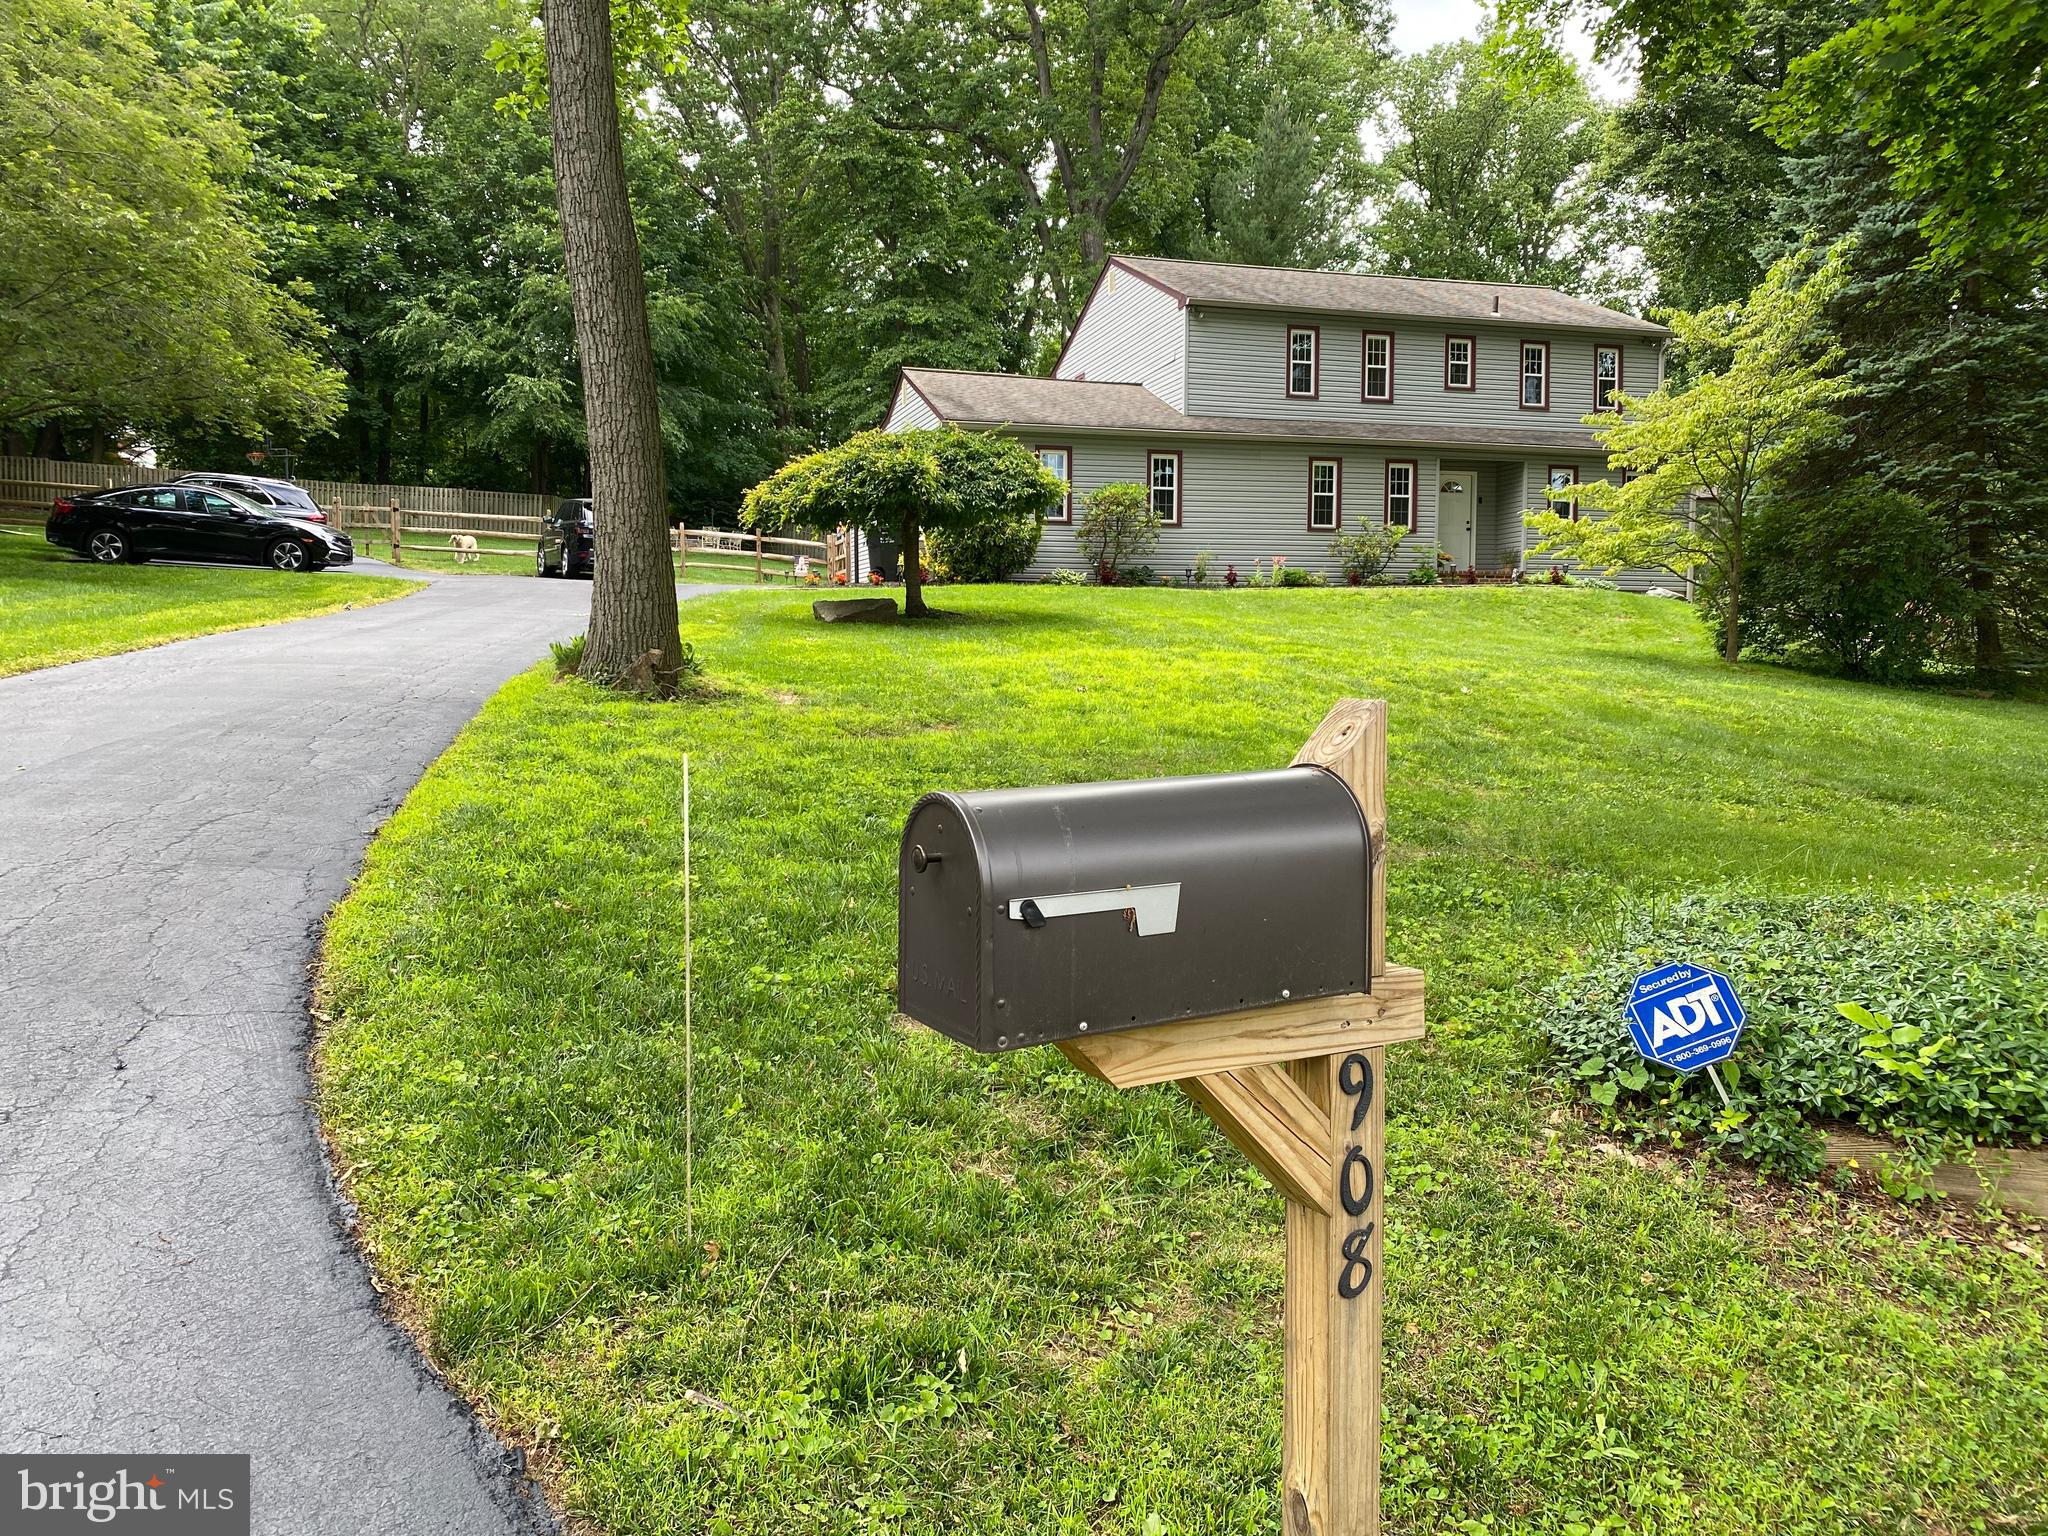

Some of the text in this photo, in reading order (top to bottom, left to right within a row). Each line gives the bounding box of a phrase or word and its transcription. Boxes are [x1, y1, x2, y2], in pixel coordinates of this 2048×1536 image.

[1639, 968, 1692, 994] Secured by
[1653, 984, 1723, 1049] ADT
